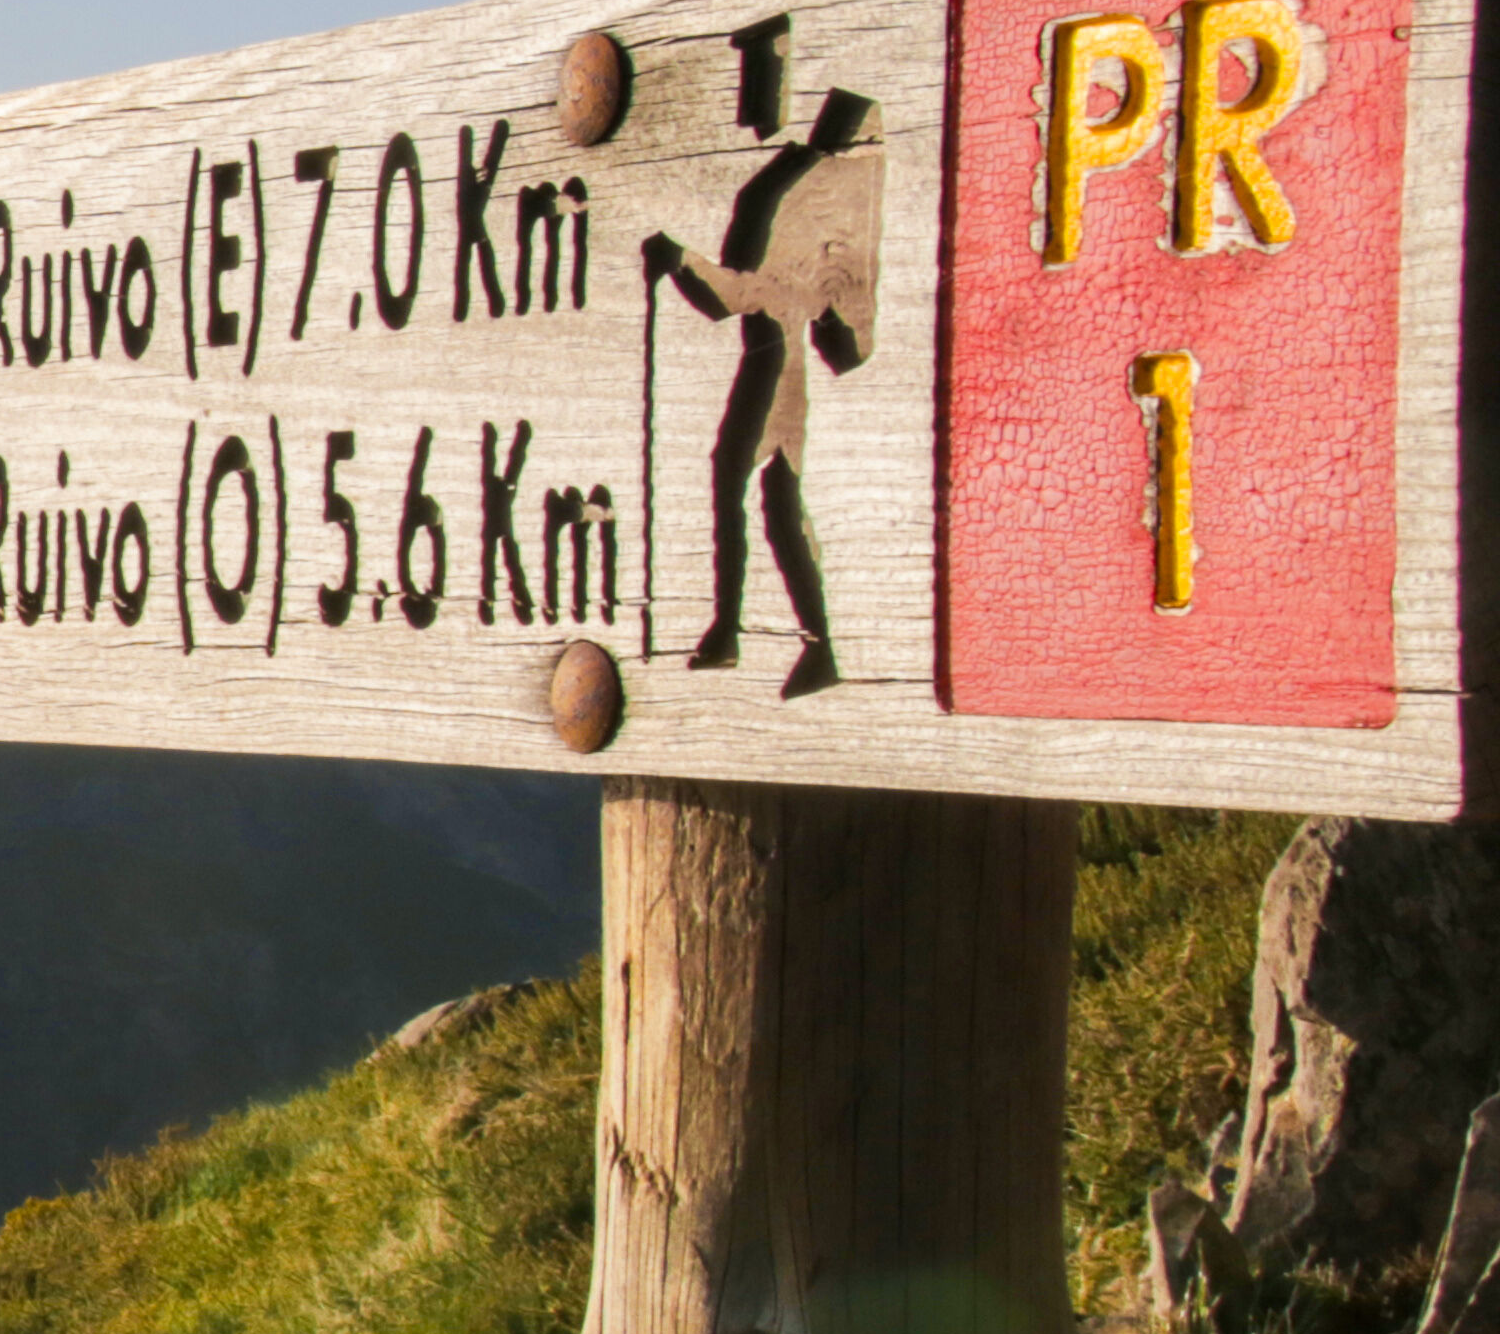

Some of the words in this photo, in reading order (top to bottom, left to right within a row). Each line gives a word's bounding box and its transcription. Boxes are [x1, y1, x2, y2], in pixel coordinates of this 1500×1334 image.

[181, 137, 267, 382] (E)
[290, 131, 425, 342] 7.0
[453, 118, 589, 323] Km
[318, 425, 447, 630] 5.6
[478, 418, 617, 626] Km
[1130, 349, 1195, 610] 1
